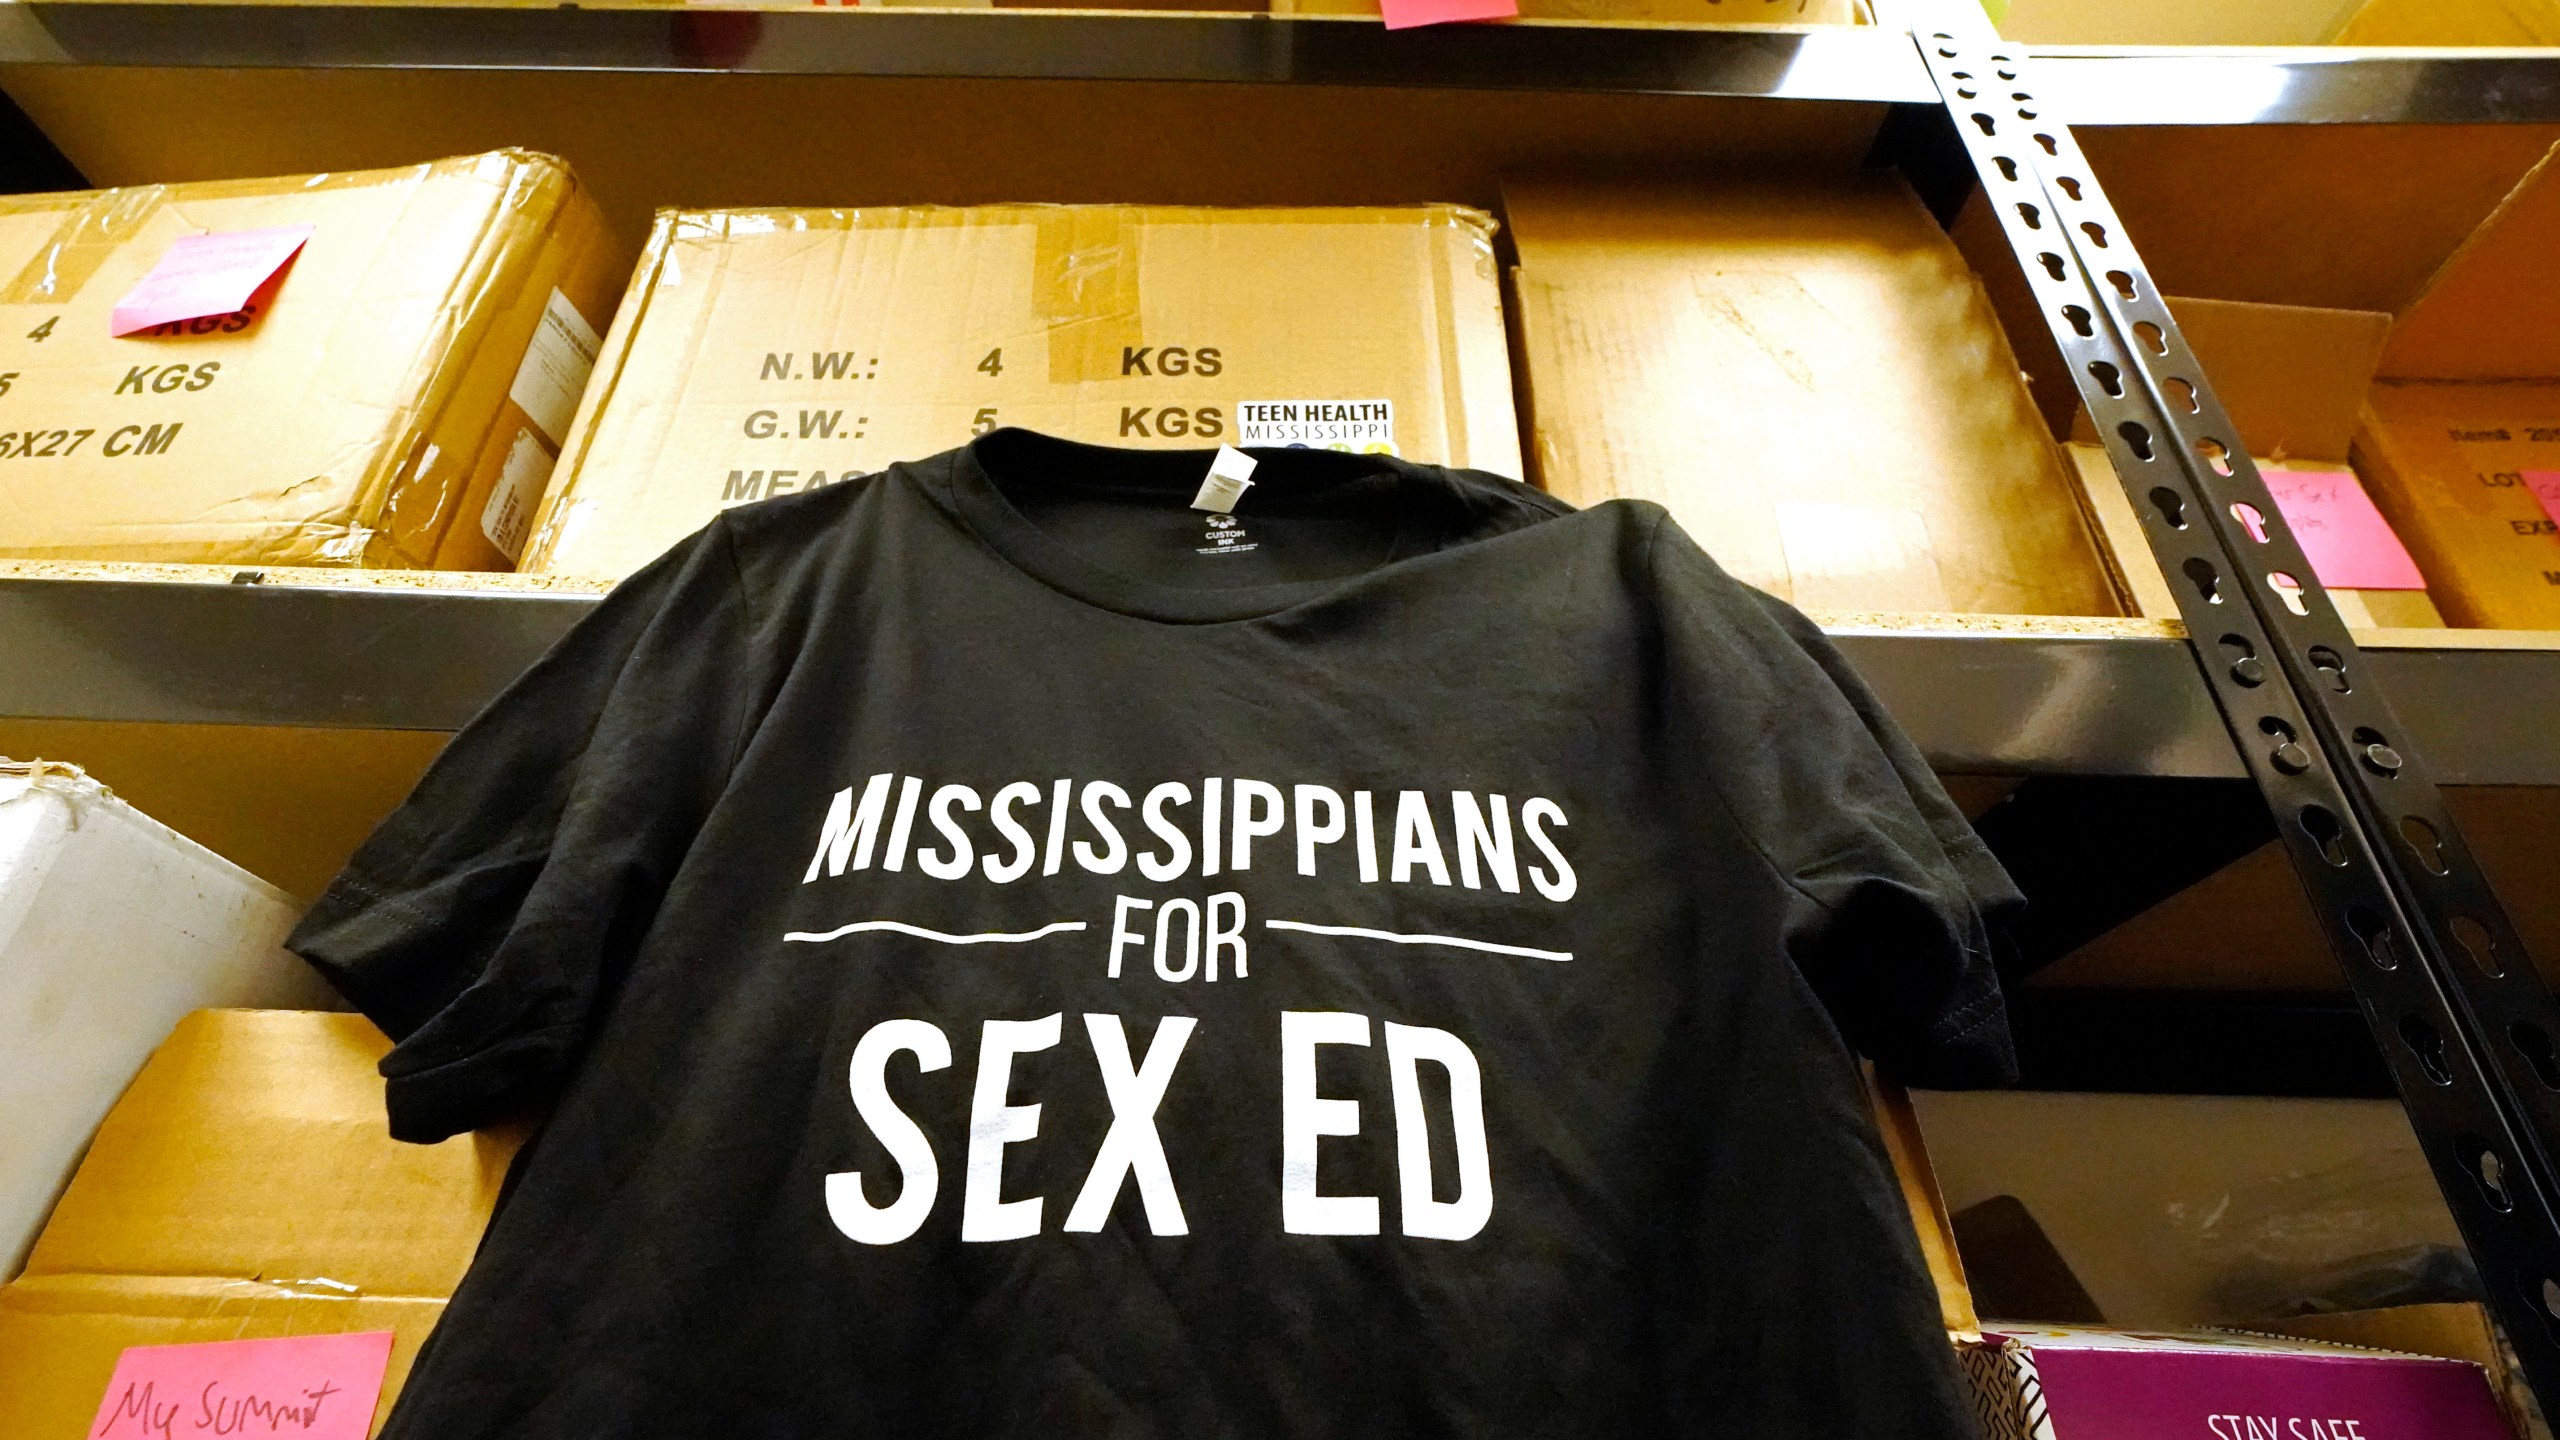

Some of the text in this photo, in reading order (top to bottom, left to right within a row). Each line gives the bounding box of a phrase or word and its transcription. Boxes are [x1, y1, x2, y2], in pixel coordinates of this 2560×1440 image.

[27, 315, 61, 343] 4
[114, 361, 221, 396] KGS
[759, 346, 1223, 380] N.W.: 4 KGS
[743, 406, 1225, 440] G.W.: 5 KGS
[1244, 403, 1388, 422] TEEN HEALTH
[102, 422, 184, 458] CM
[1245, 423, 1388, 440] MISSISSIPPI
[721, 470, 868, 500] MEA
[1205, 530, 1246, 540] CUSTOM
[1217, 538, 1235, 546] INK
[801, 772, 1579, 904] MISSISSIPPIANS
[1107, 891, 1249, 983] FOR
[824, 1010, 1494, 1245] SEX ED
[2207, 1414, 2277, 1440] STAY
